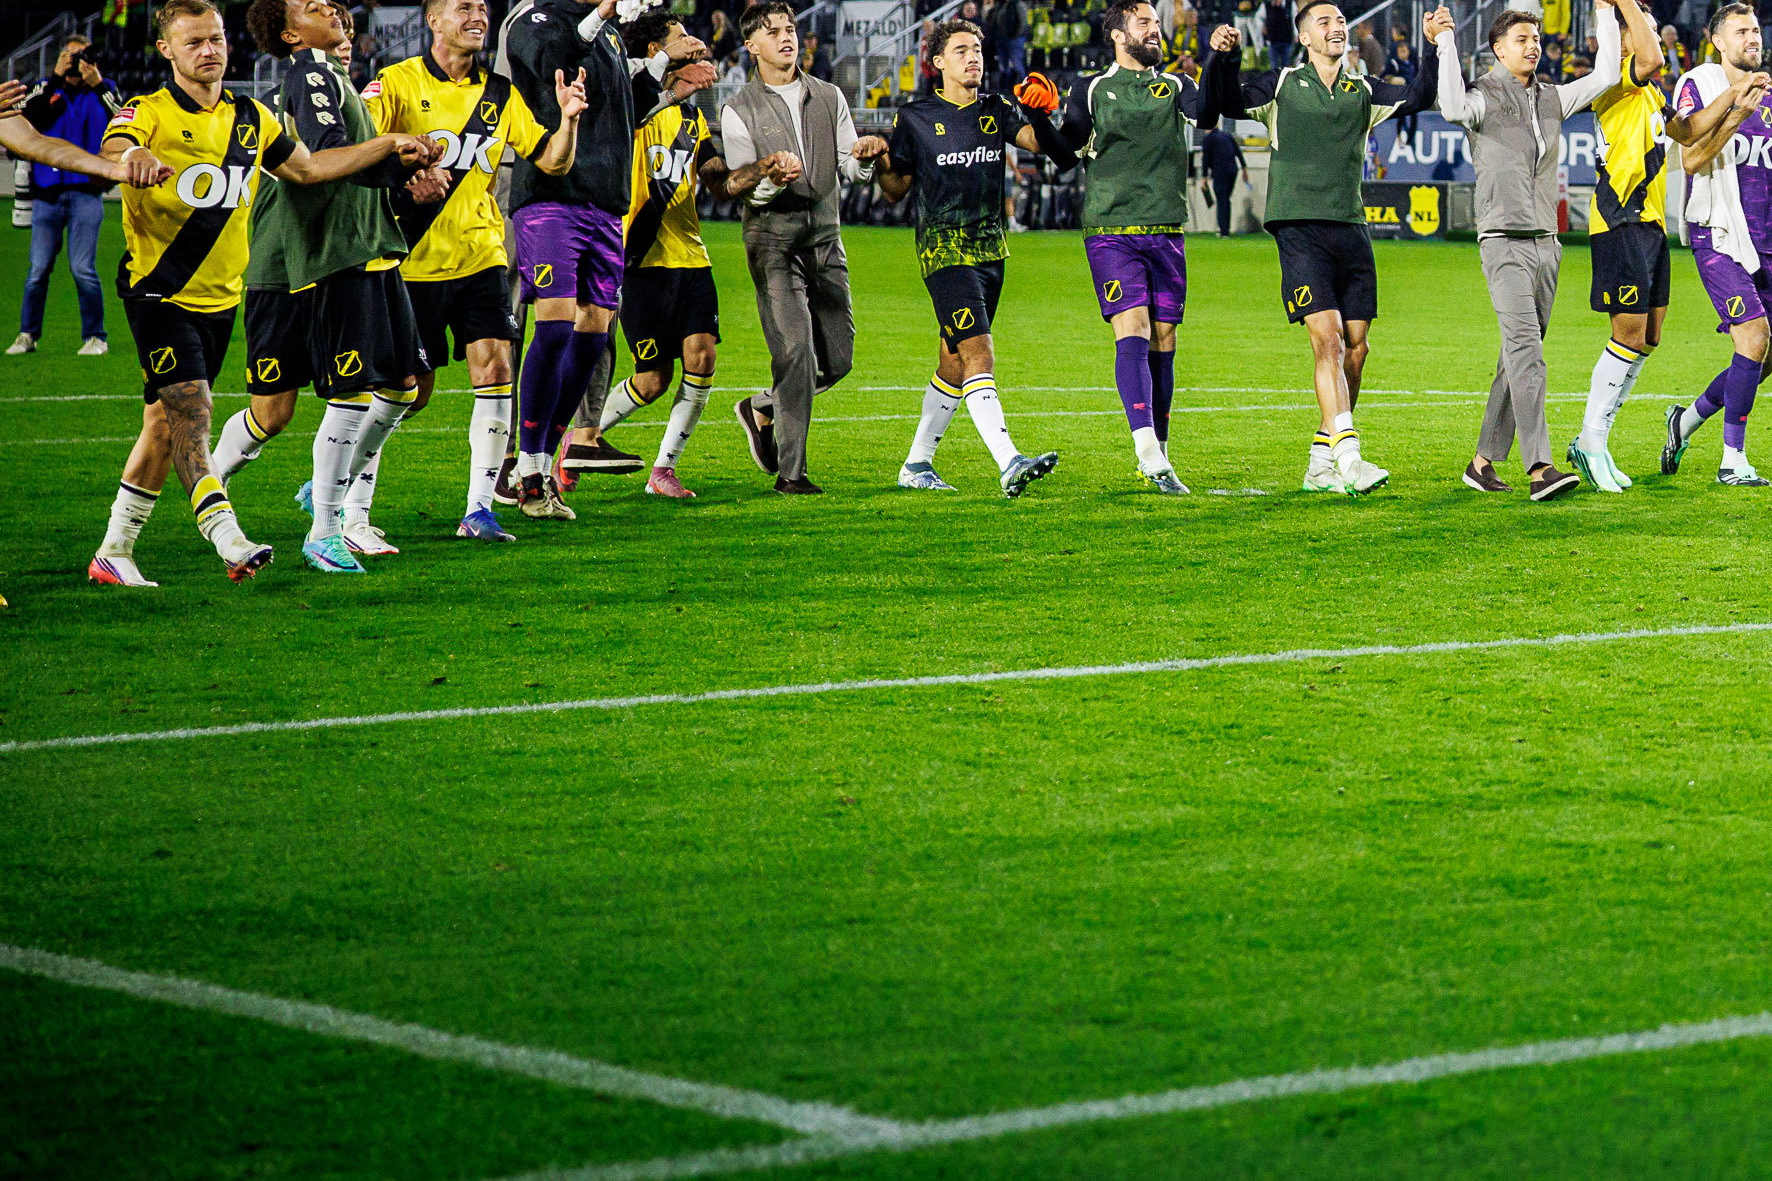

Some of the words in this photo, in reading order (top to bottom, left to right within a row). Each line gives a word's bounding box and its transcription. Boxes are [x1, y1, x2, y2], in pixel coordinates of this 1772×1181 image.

[424, 129, 500, 174] OK
[645, 144, 696, 185] OK
[936, 146, 1002, 167] easyflex
[176, 163, 256, 208] OK
